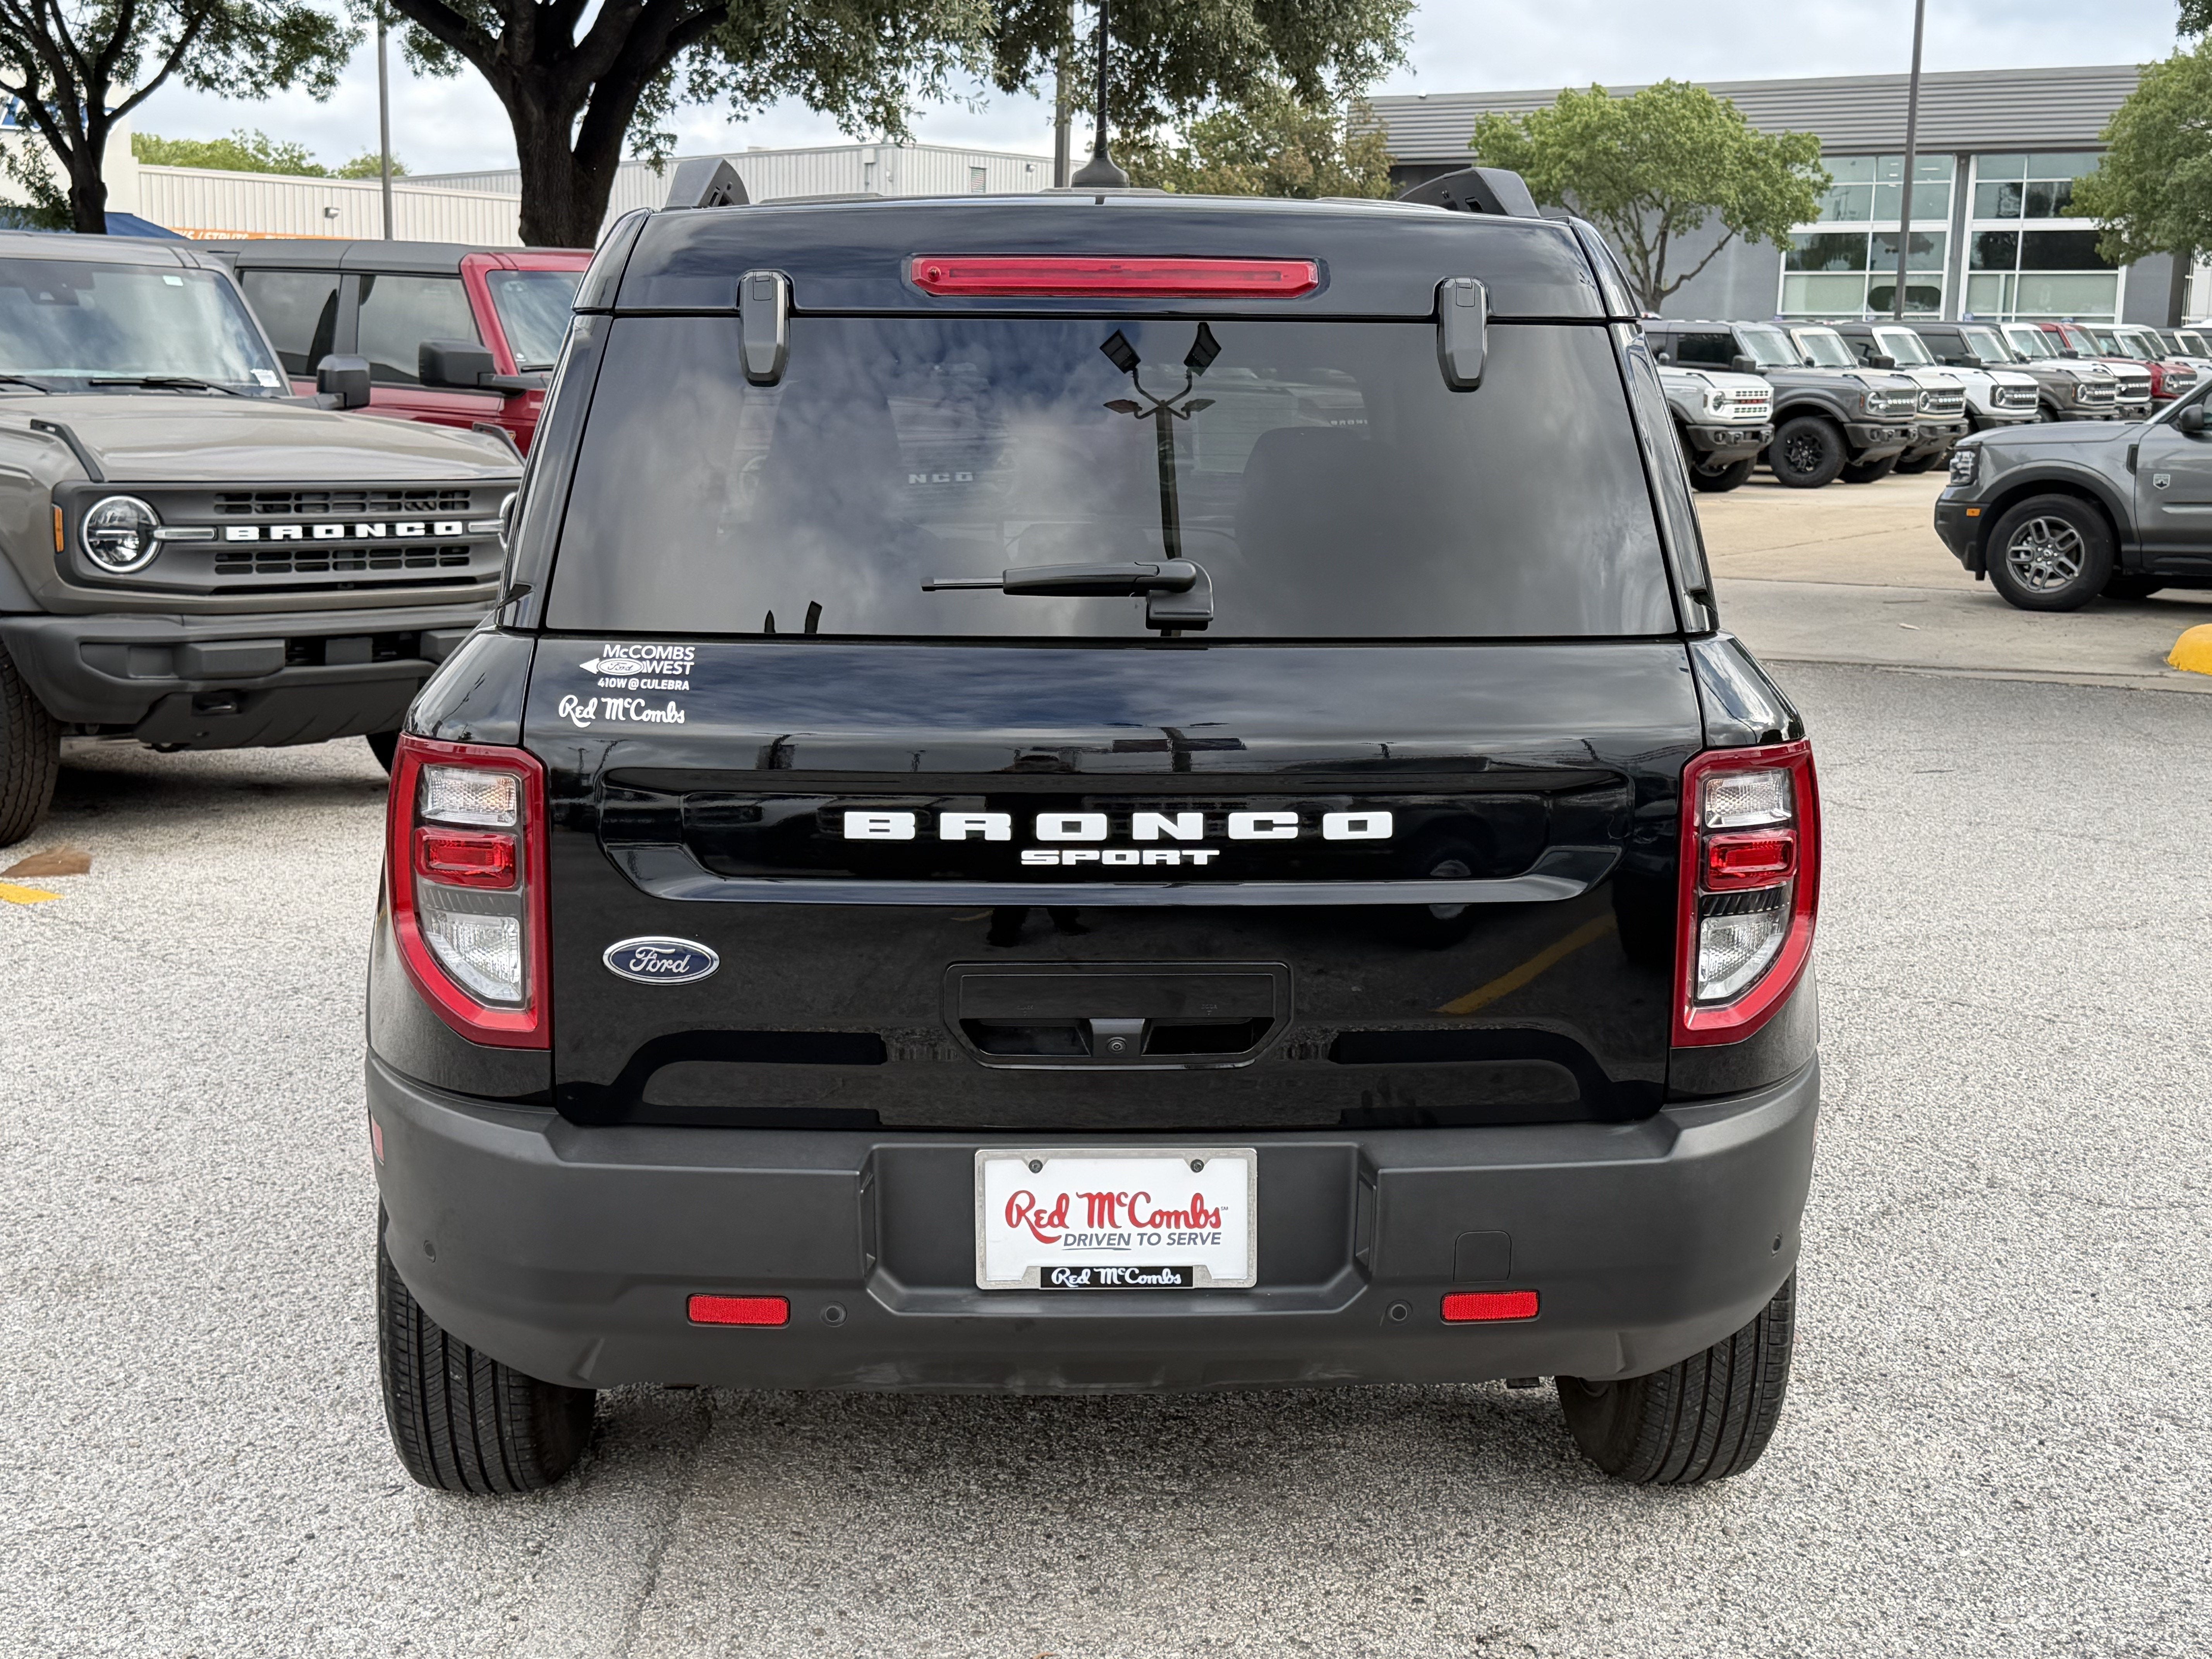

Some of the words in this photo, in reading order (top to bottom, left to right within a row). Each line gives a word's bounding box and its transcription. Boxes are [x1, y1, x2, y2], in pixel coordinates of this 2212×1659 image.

[226, 521, 463, 541] BRONCO
[603, 644, 696, 660] McCOMBS
[646, 660, 695, 675] WEST
[558, 695, 598, 728] Red
[601, 697, 685, 724] McCombs
[844, 811, 1393, 841] BRONCO
[1021, 850, 1220, 865] SPORT
[629, 946, 691, 973] Ford
[1005, 1190, 1070, 1244] Red
[1076, 1191, 1221, 1229] McCombs
[1063, 1233, 1132, 1247] DRIVEN
[1137, 1233, 1162, 1246] TO
[1166, 1232, 1222, 1246] SERVE
[1051, 1267, 1090, 1288] Red
[1094, 1267, 1182, 1285] McCombs
